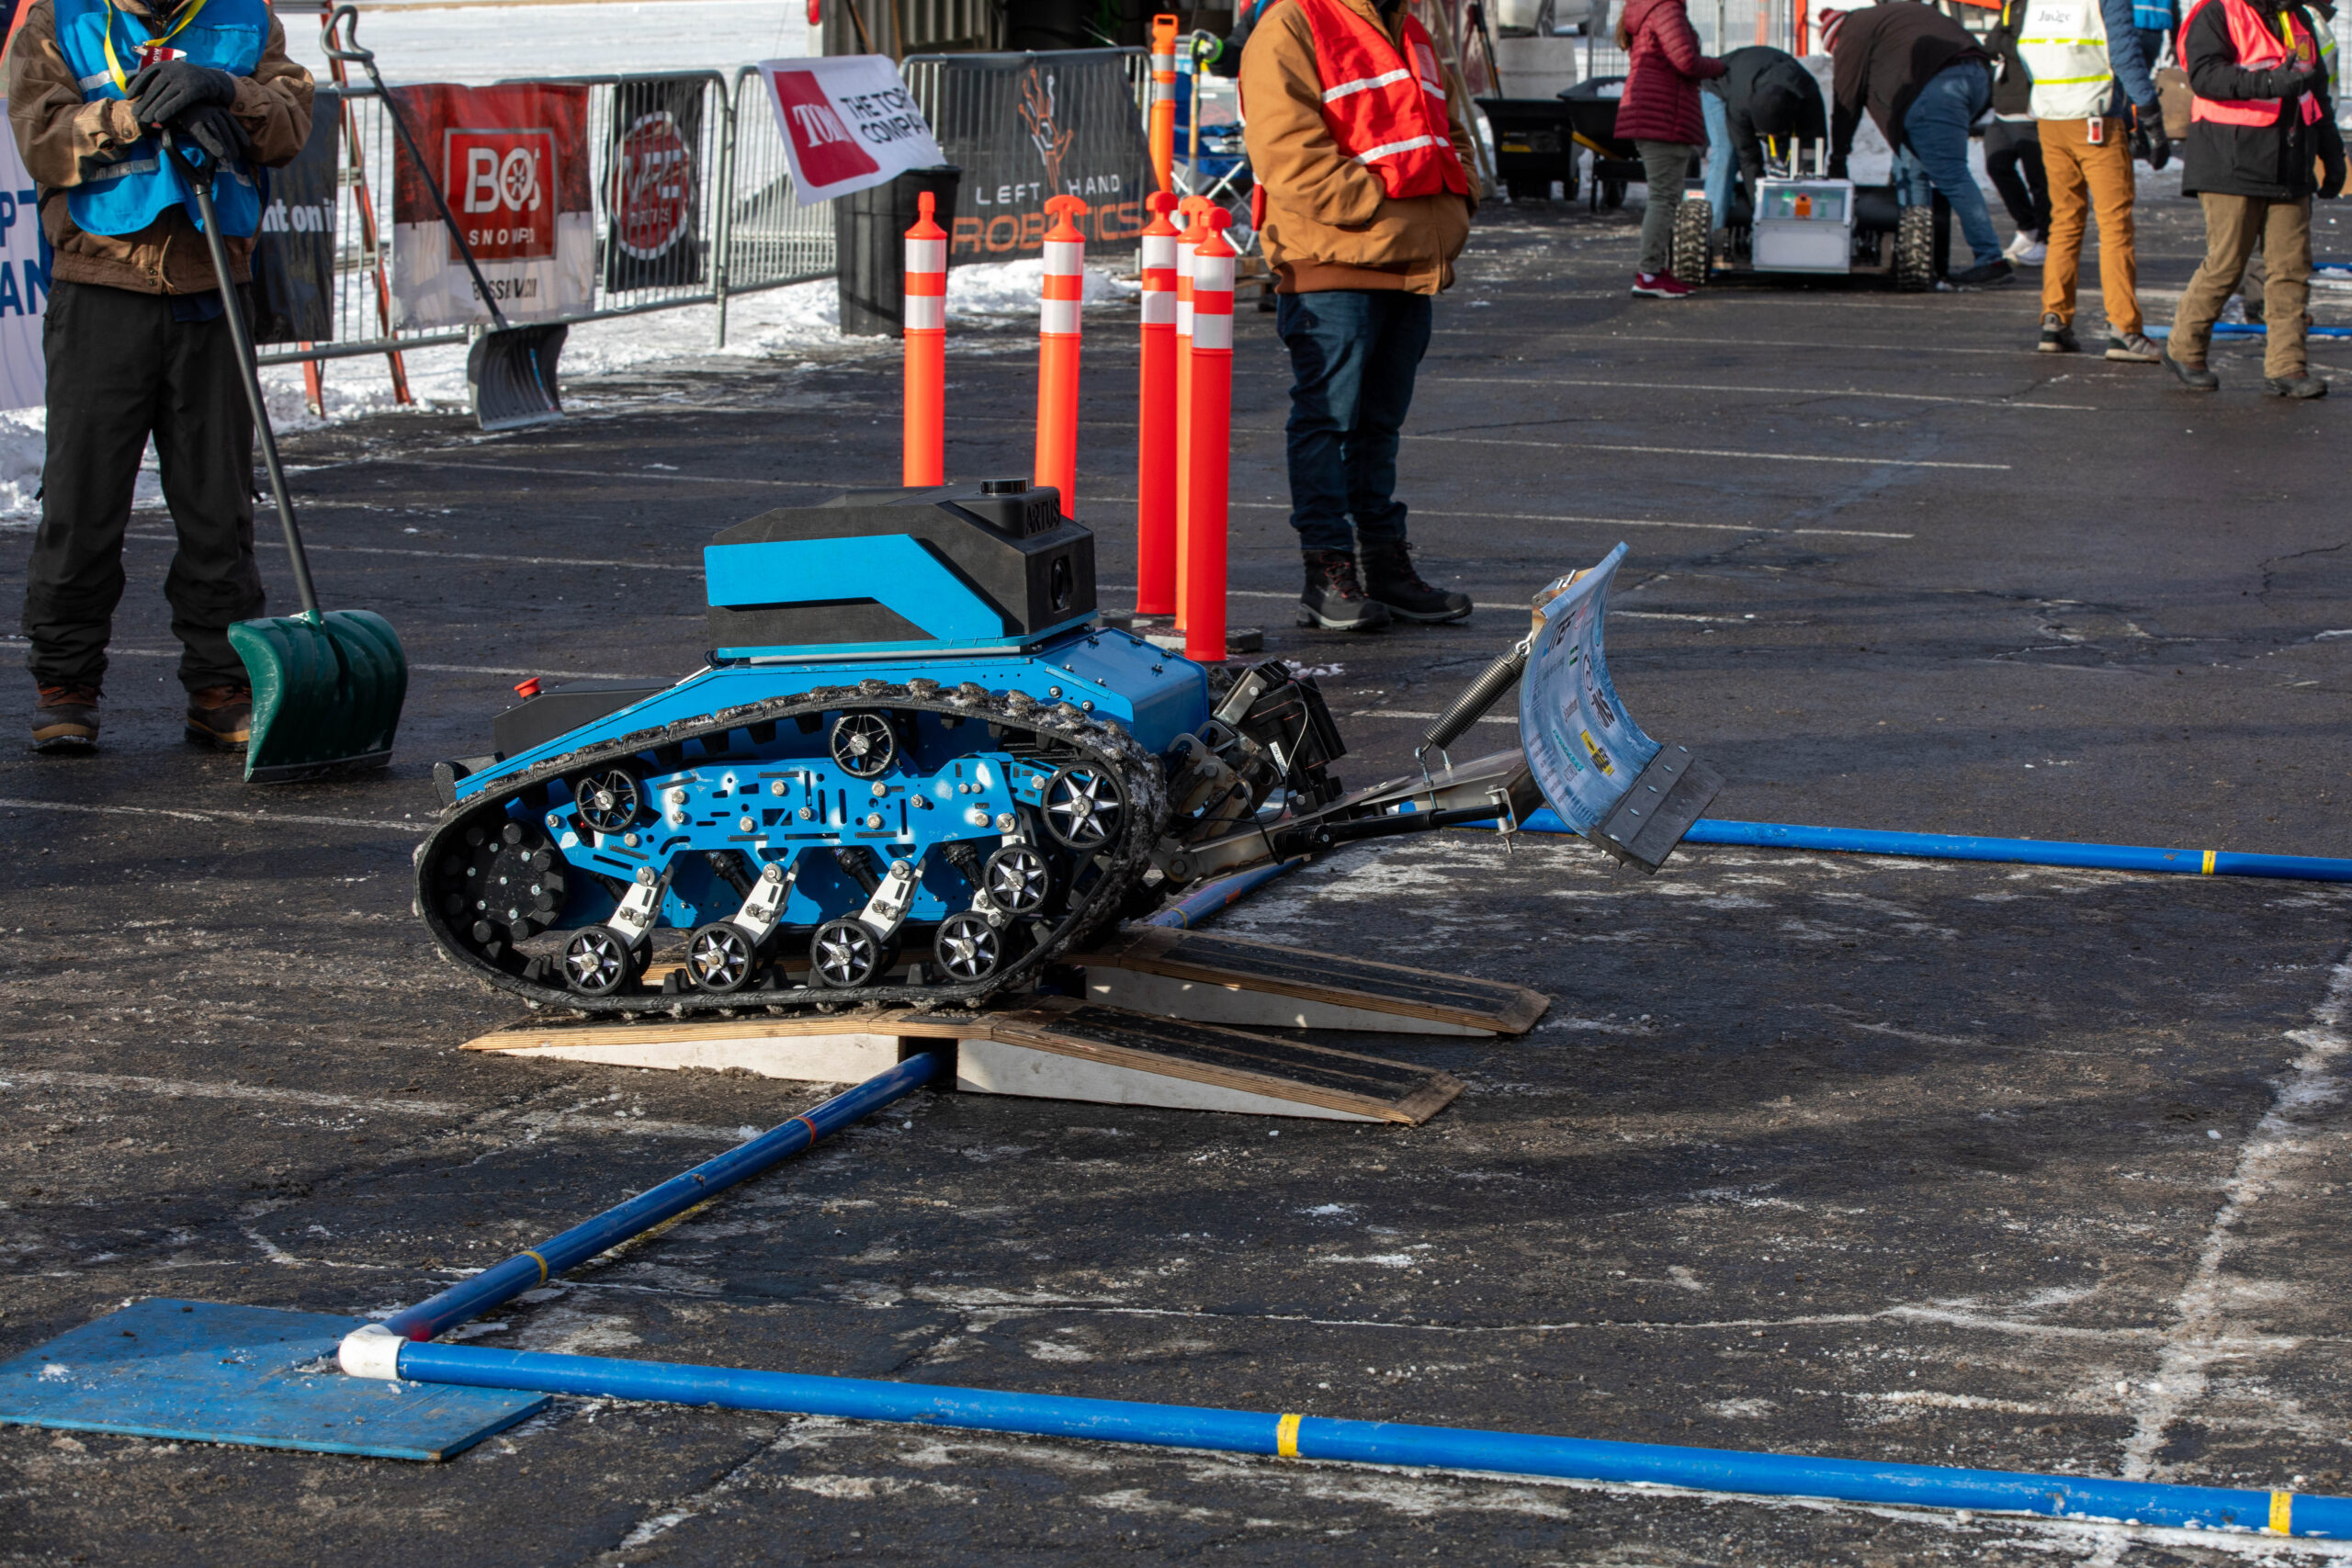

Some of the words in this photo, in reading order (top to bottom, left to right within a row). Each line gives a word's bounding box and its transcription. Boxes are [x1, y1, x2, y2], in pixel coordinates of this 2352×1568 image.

[839, 96, 882, 120] THE
[976, 182, 1041, 206] LEFT
[1066, 174, 1121, 197] HAND
[291, 205, 324, 232] on
[1025, 497, 1060, 536] ARTUS
